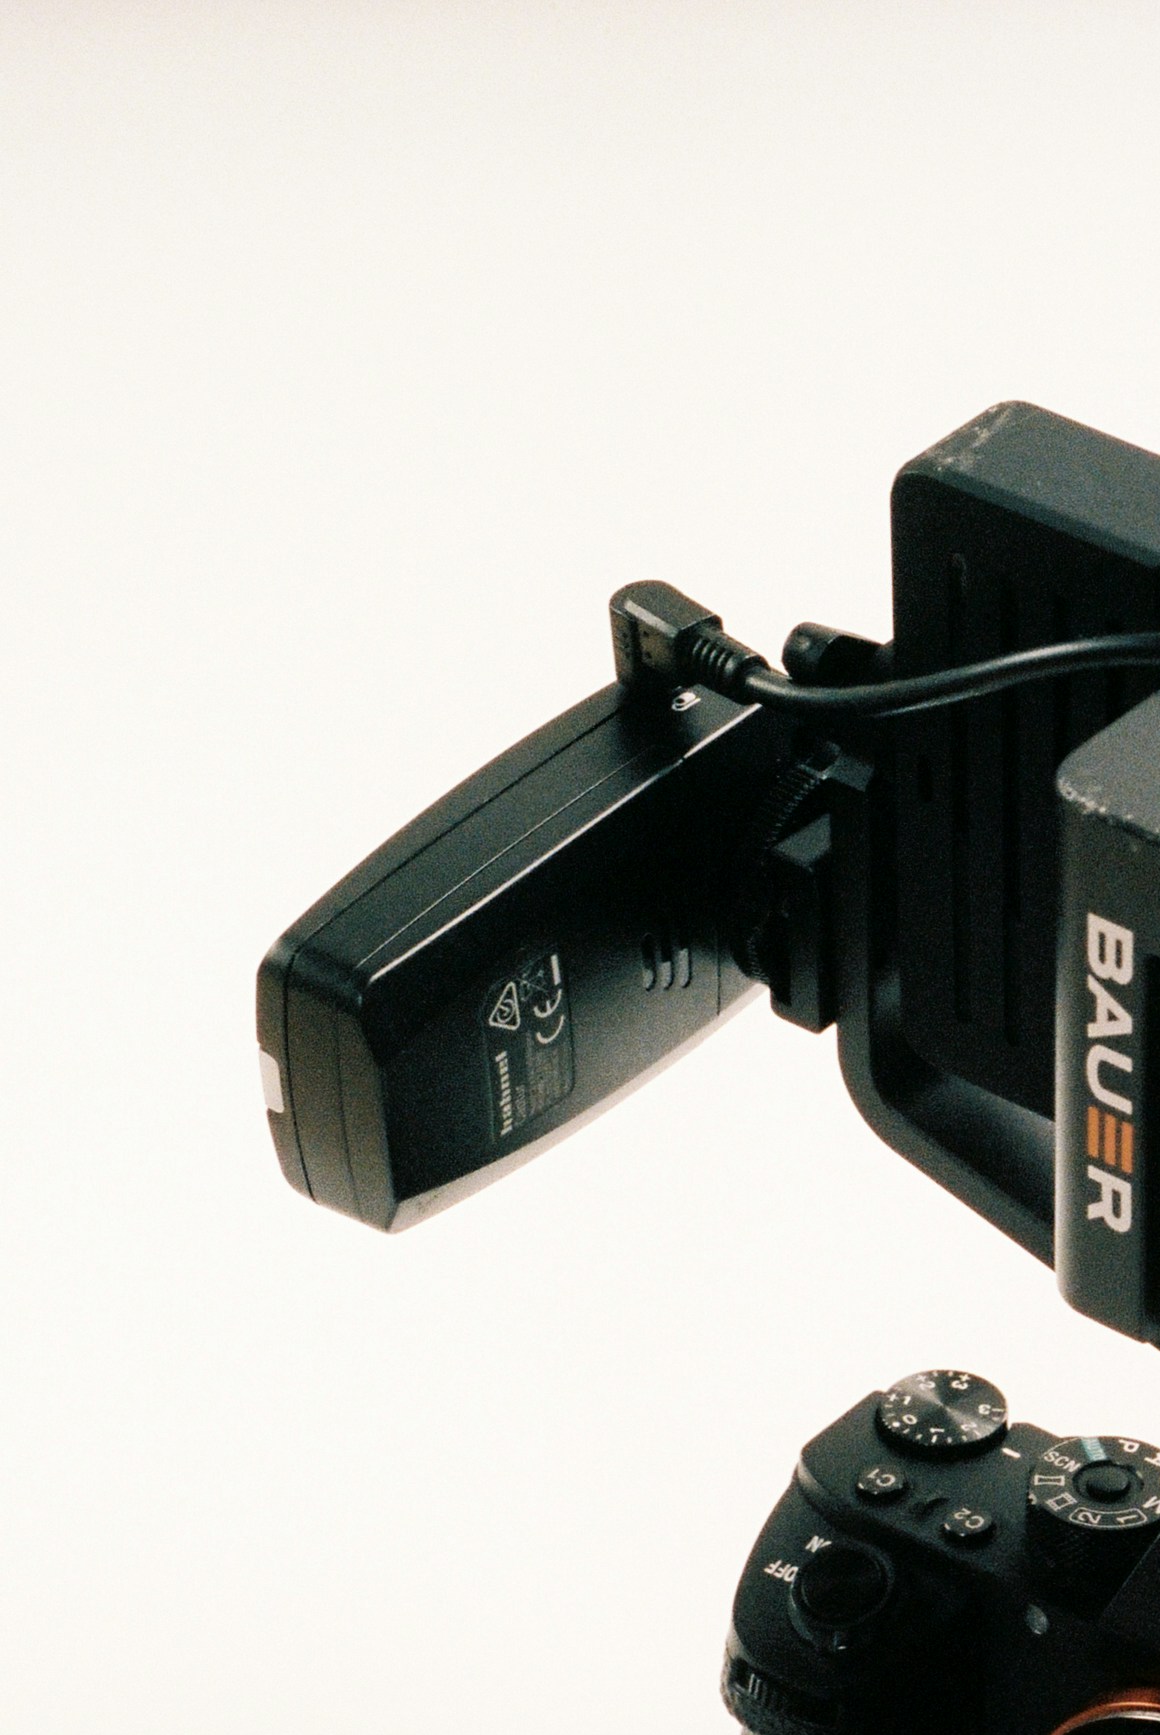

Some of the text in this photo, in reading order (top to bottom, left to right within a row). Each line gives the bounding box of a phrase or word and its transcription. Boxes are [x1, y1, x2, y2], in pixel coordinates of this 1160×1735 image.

[1086, 912, 1135, 1235] BAUER
[1118, 1439, 1140, 1453] P
[1043, 1451, 1081, 1473] SCN
[866, 1468, 896, 1487] C1
[953, 1508, 985, 1529] C2
[805, 1535, 832, 1553] N
[763, 1559, 799, 1582] OFF
